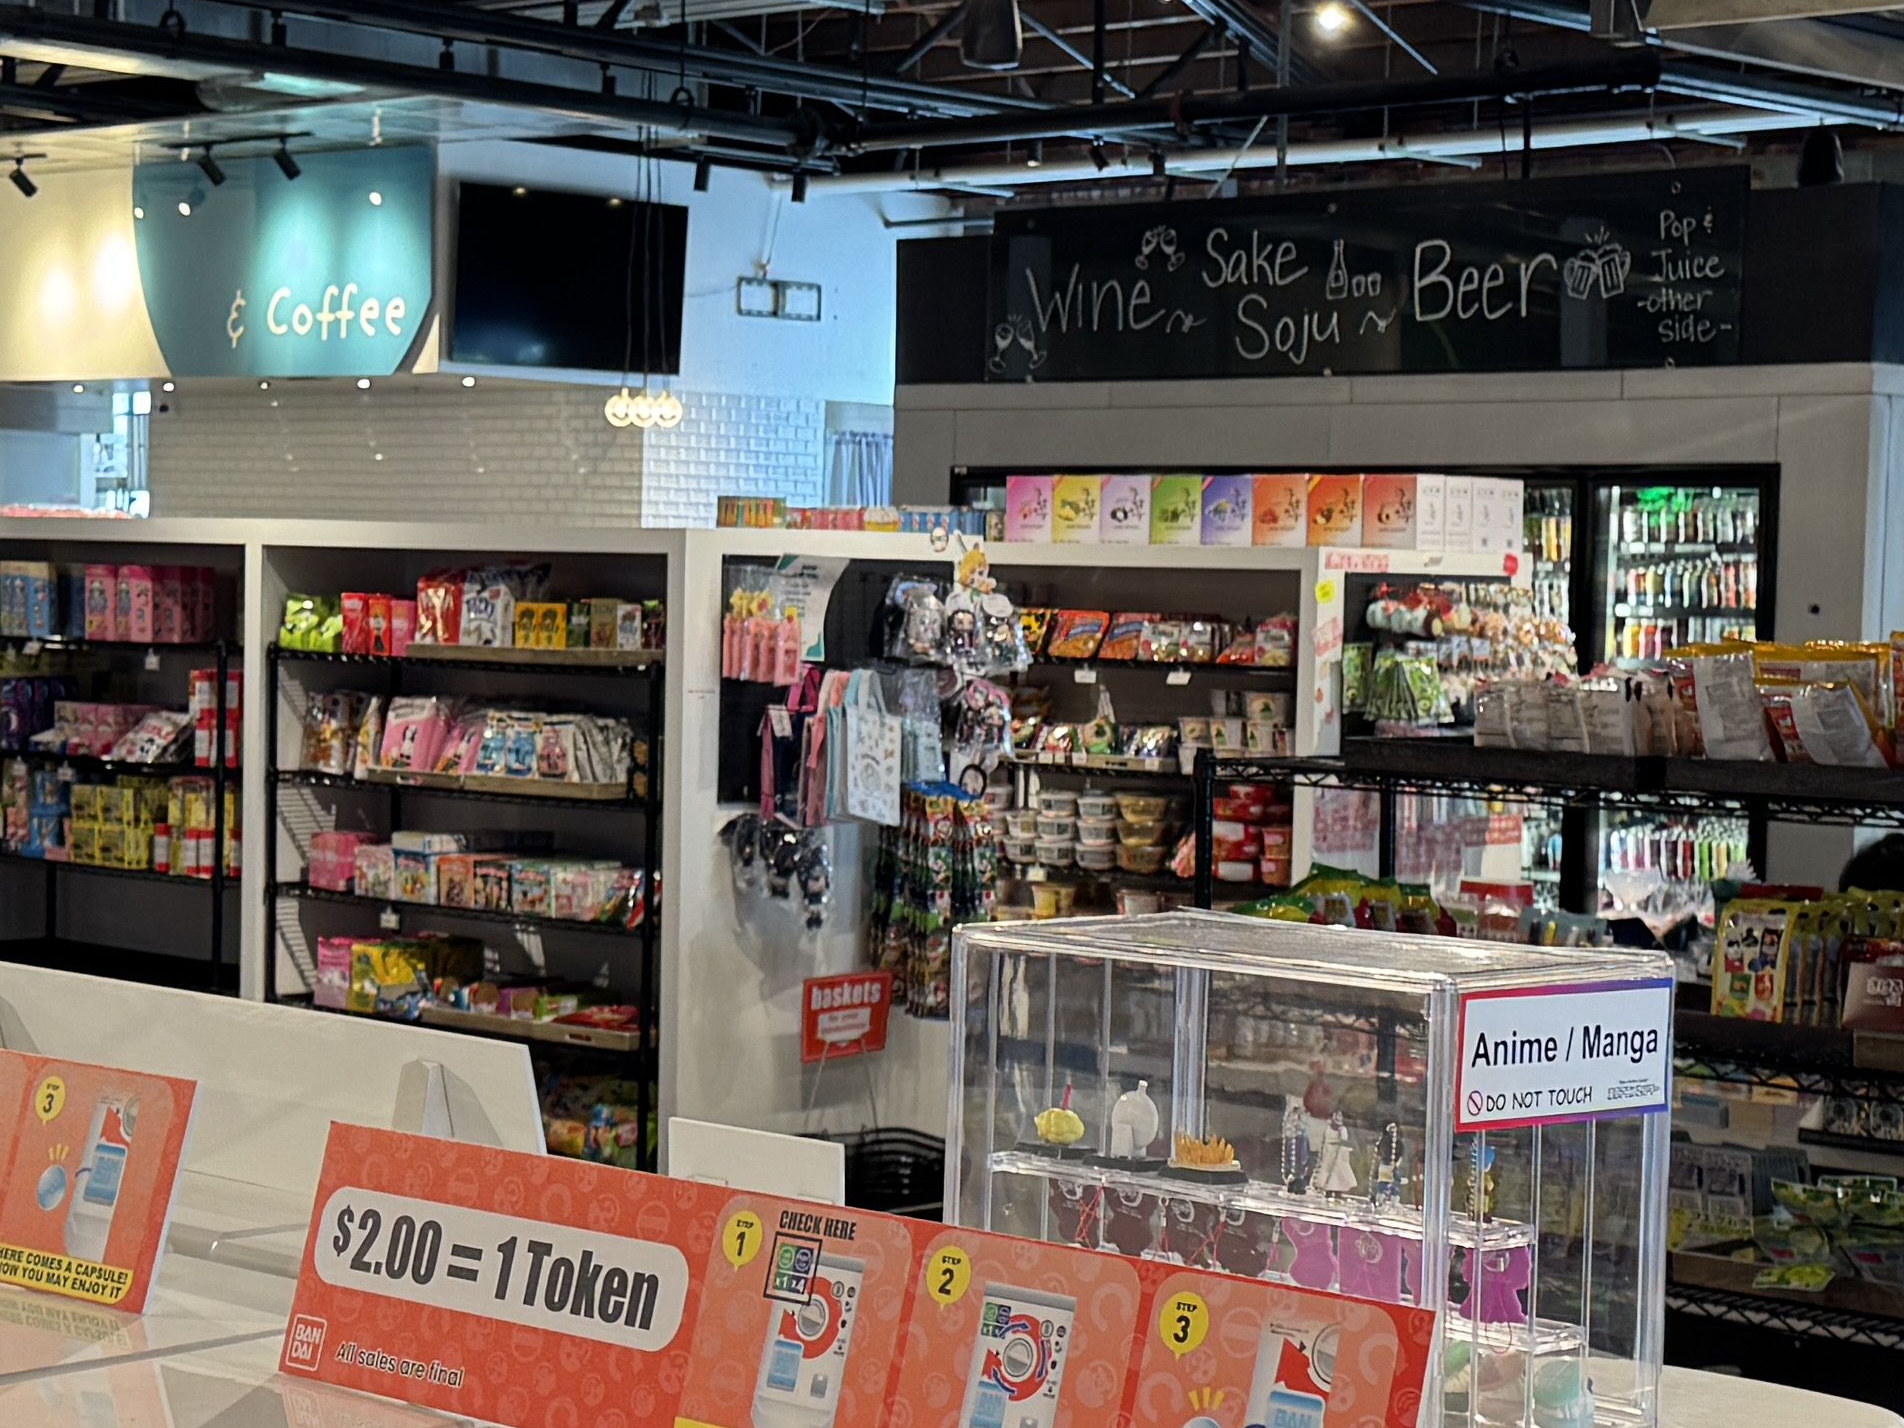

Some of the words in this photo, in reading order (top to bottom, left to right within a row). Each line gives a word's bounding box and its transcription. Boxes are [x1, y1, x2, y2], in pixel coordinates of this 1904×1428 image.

[1661, 213, 1694, 239] Pop
[1203, 230, 1309, 291] Sake
[1651, 248, 1725, 280] Juice
[1414, 239, 1559, 322] Beer
[266, 283, 406, 340] Coffee
[1026, 264, 1166, 335] Wine
[1235, 297, 1341, 364] Soju
[811, 982, 881, 1010] baskets
[1471, 1030, 1557, 1068] Anime
[1566, 1027, 1574, 1062] /
[1582, 1025, 1658, 1063] Manga
[1487, 1094, 1506, 1112] DO
[1512, 1091, 1543, 1109] NOT
[1548, 1086, 1593, 1107] TOUCH
[779, 1209, 822, 1238] CHECK
[823, 1216, 856, 1242] HERE
[737, 1230, 747, 1257] 1
[332, 1203, 443, 1286] $2.00
[447, 1244, 485, 1283] =
[495, 1236, 517, 1301] 1
[522, 1241, 659, 1331] Token
[938, 1267, 954, 1295] 2
[294, 1324, 322, 1344] BAN
[1175, 1314, 1191, 1344] 3
[292, 1340, 313, 1361] DAI
[335, 1342, 355, 1364] All
[357, 1348, 396, 1371] sales
[399, 1360, 424, 1379] are
[426, 1360, 464, 1388] final
